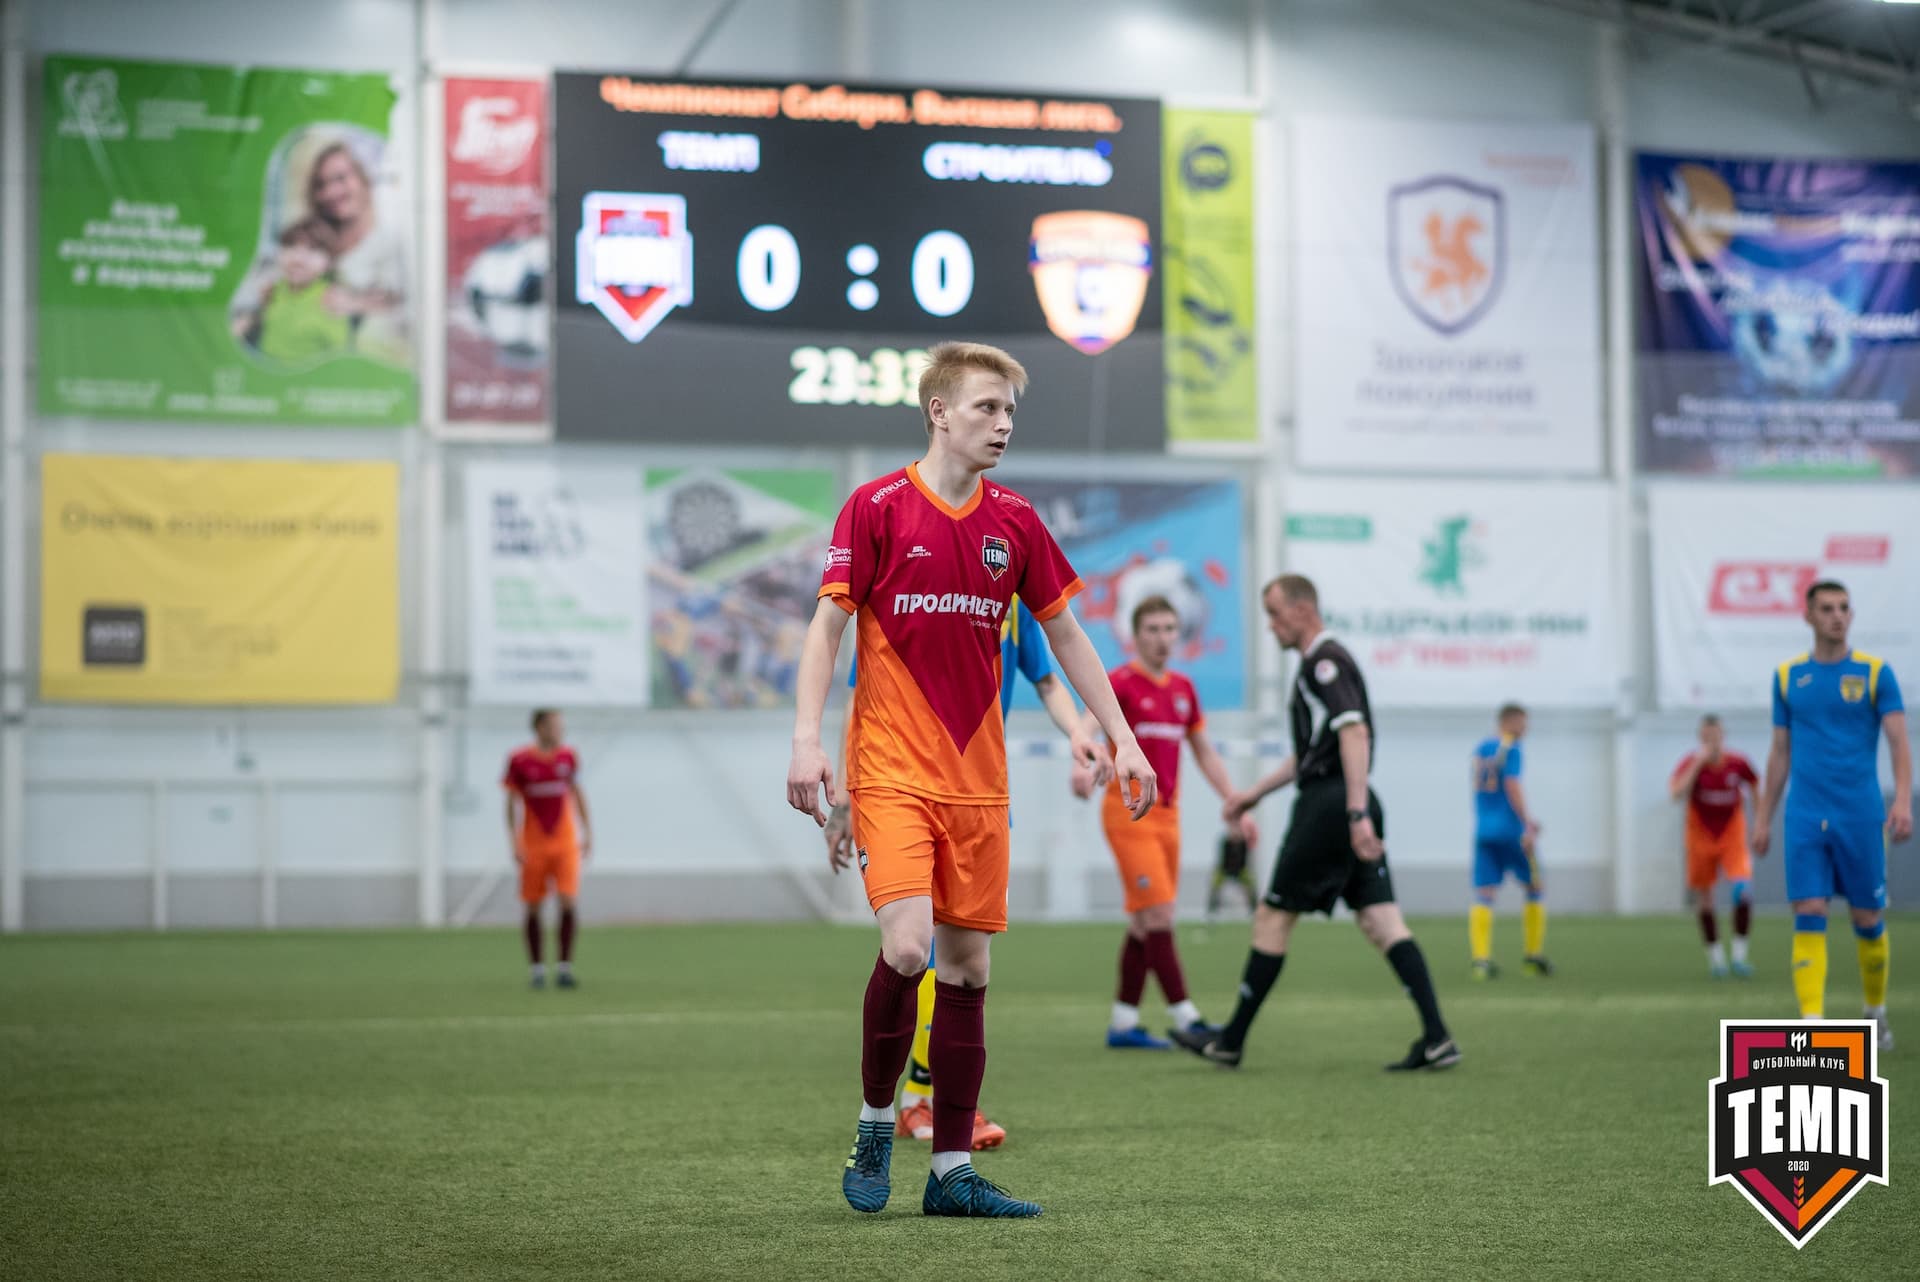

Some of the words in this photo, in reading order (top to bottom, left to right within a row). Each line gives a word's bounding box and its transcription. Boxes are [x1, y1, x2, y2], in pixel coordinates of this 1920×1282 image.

[657, 131, 760, 172] ТЕМП
[923, 142, 1113, 186] СТРОИТЕЛЬ
[737, 225, 800, 311] 0
[911, 230, 974, 316] 0
[985, 548, 1007, 567] ТЕМП
